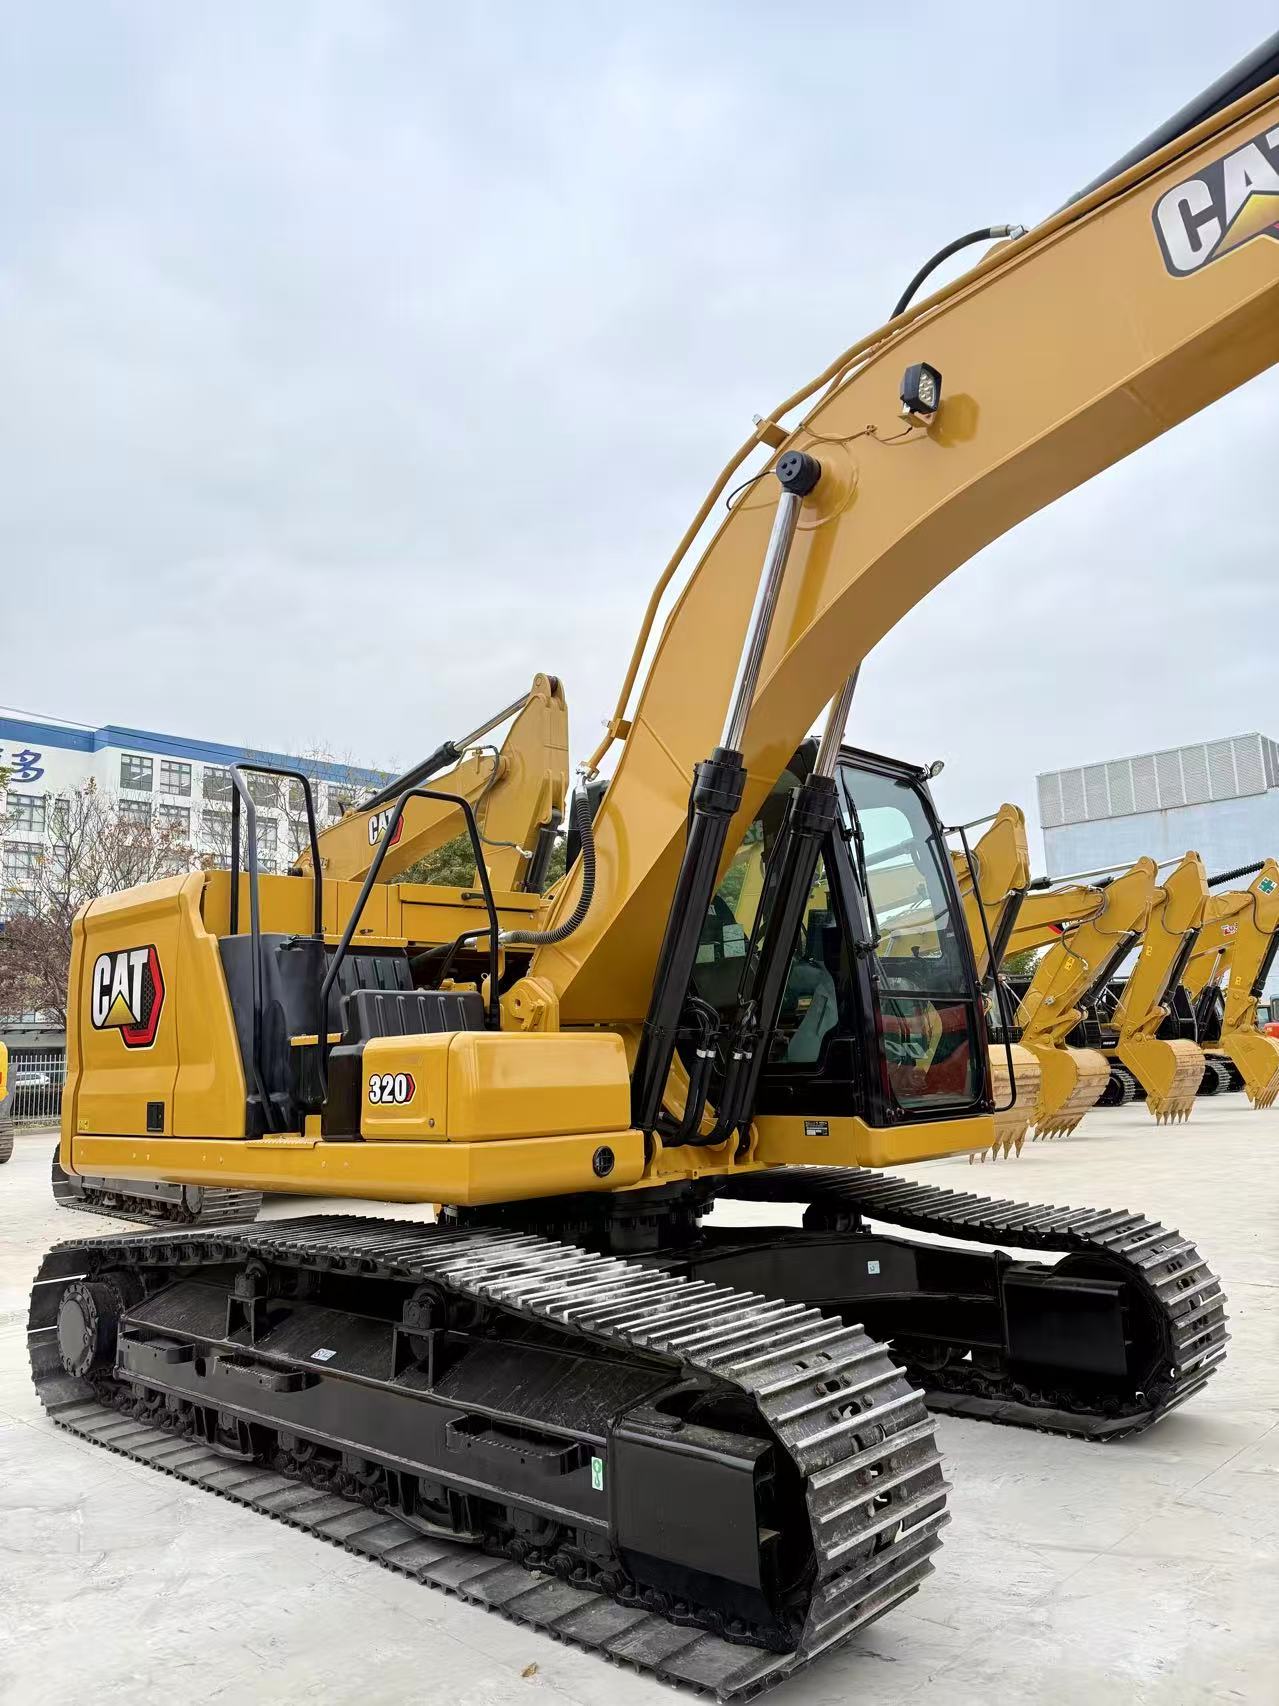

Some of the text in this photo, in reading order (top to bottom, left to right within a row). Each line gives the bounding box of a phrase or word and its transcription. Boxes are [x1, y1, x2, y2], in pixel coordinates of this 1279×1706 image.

[1157, 127, 1279, 271] CA
[0, 748, 45, 783] 多
[93, 948, 149, 1027] CAT
[369, 1073, 407, 1103] 320
